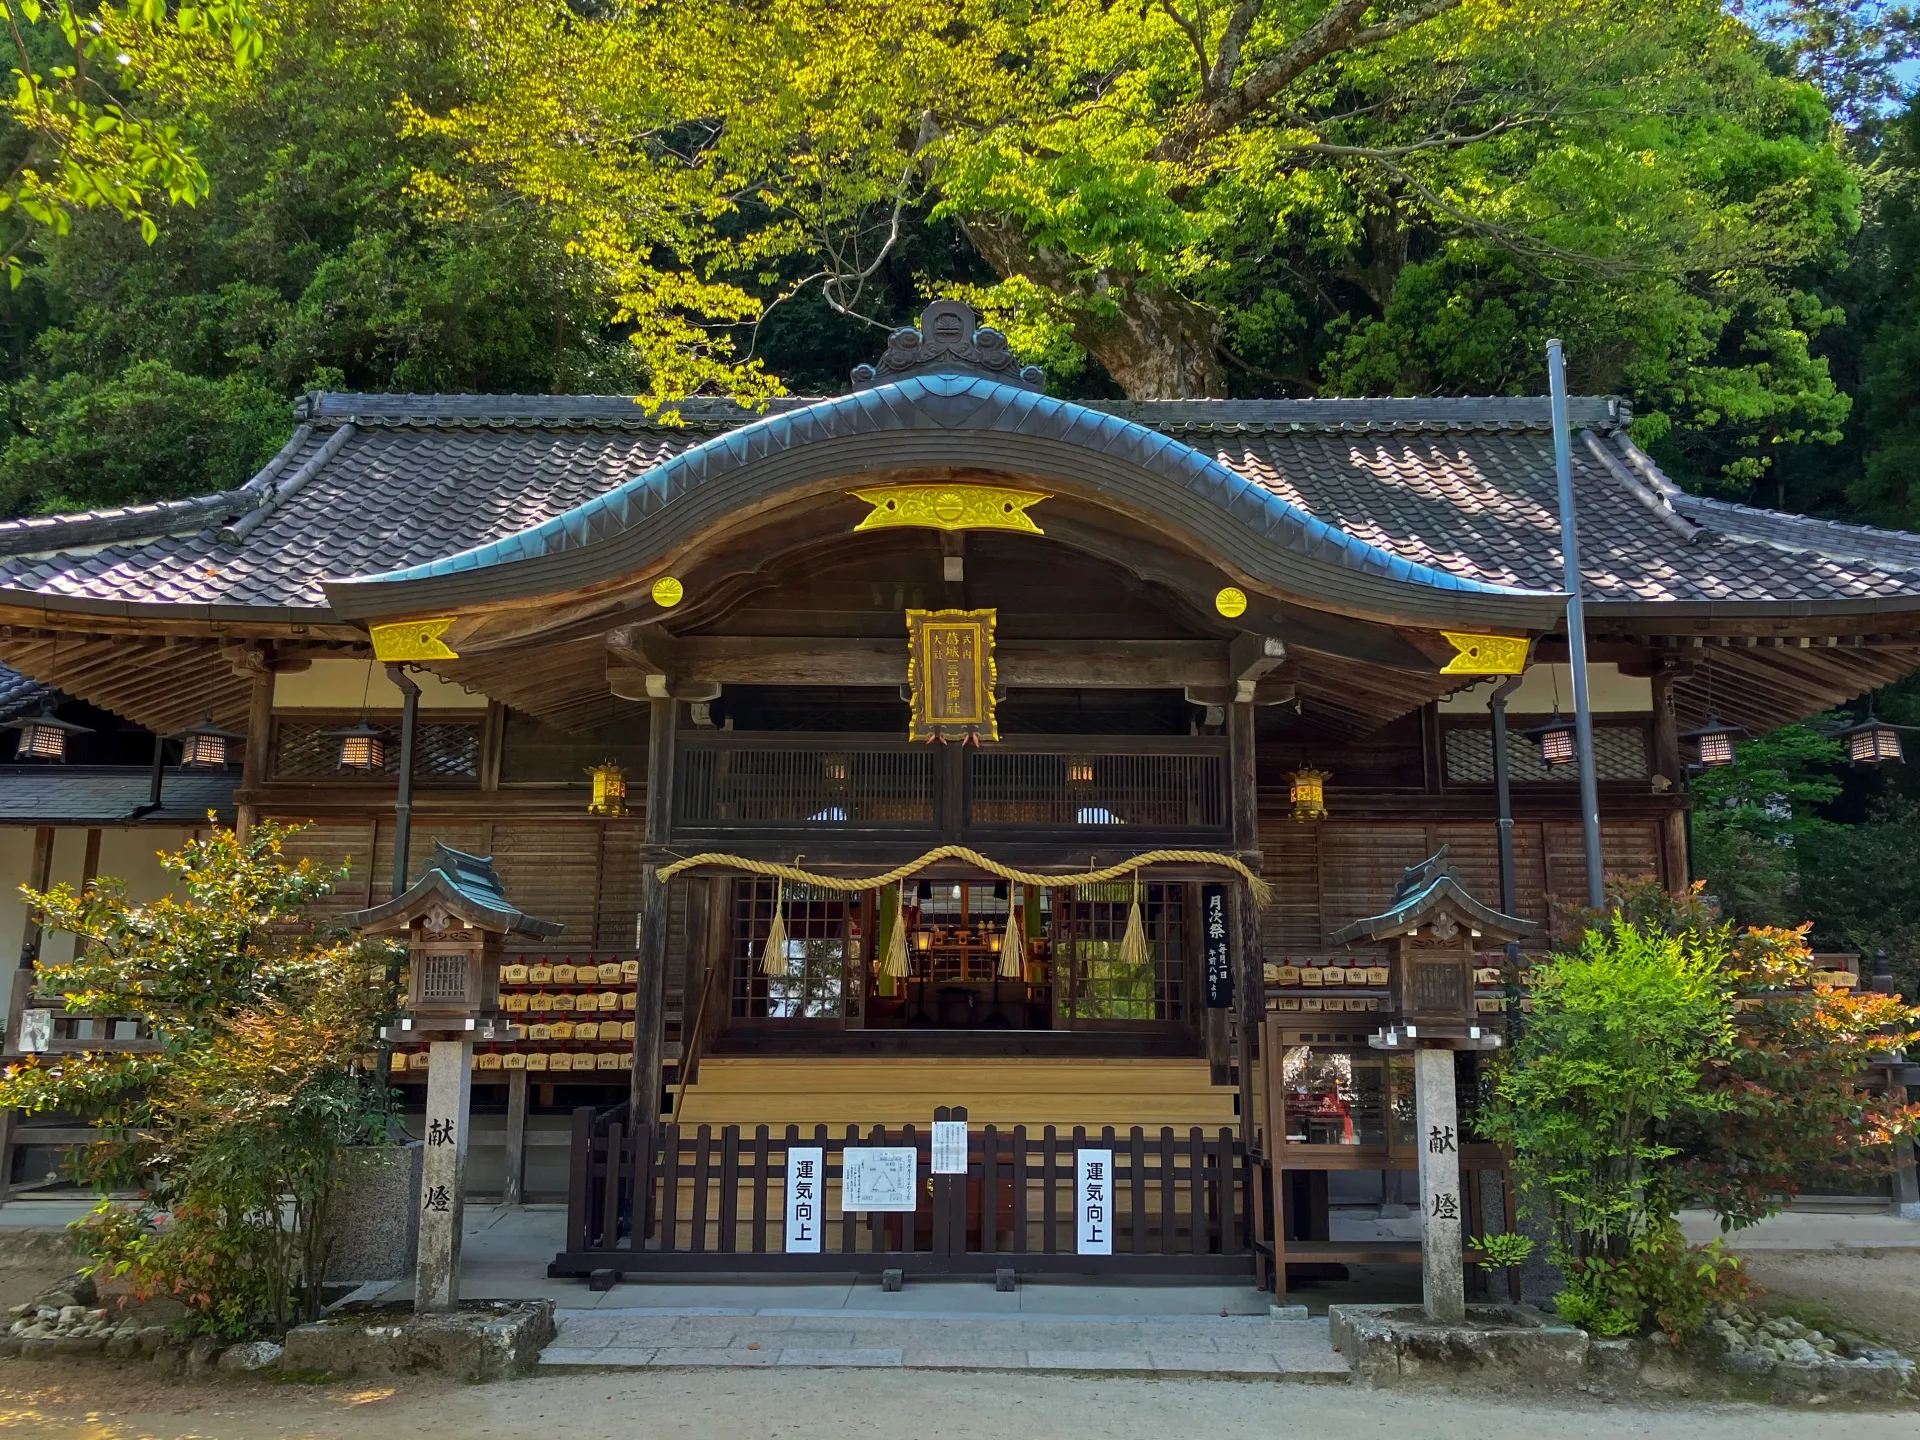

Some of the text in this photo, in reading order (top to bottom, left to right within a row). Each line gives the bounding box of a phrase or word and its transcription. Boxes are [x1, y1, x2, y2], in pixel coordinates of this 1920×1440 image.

[934, 635, 943, 659] 大社
[946, 632, 960, 713] 葛城一言主神社
[963, 635, 972, 659] 式内
[1208, 894, 1226, 939] 月次祭
[1208, 948, 1218, 1001] 午前八時より
[1217, 942, 1228, 979] 毎月一日
[424, 1119, 454, 1212] 献燈
[1430, 1126, 1458, 1220] 献燈
[794, 1159, 814, 1242] 運気向上
[1086, 1161, 1104, 1243] 運気向上
